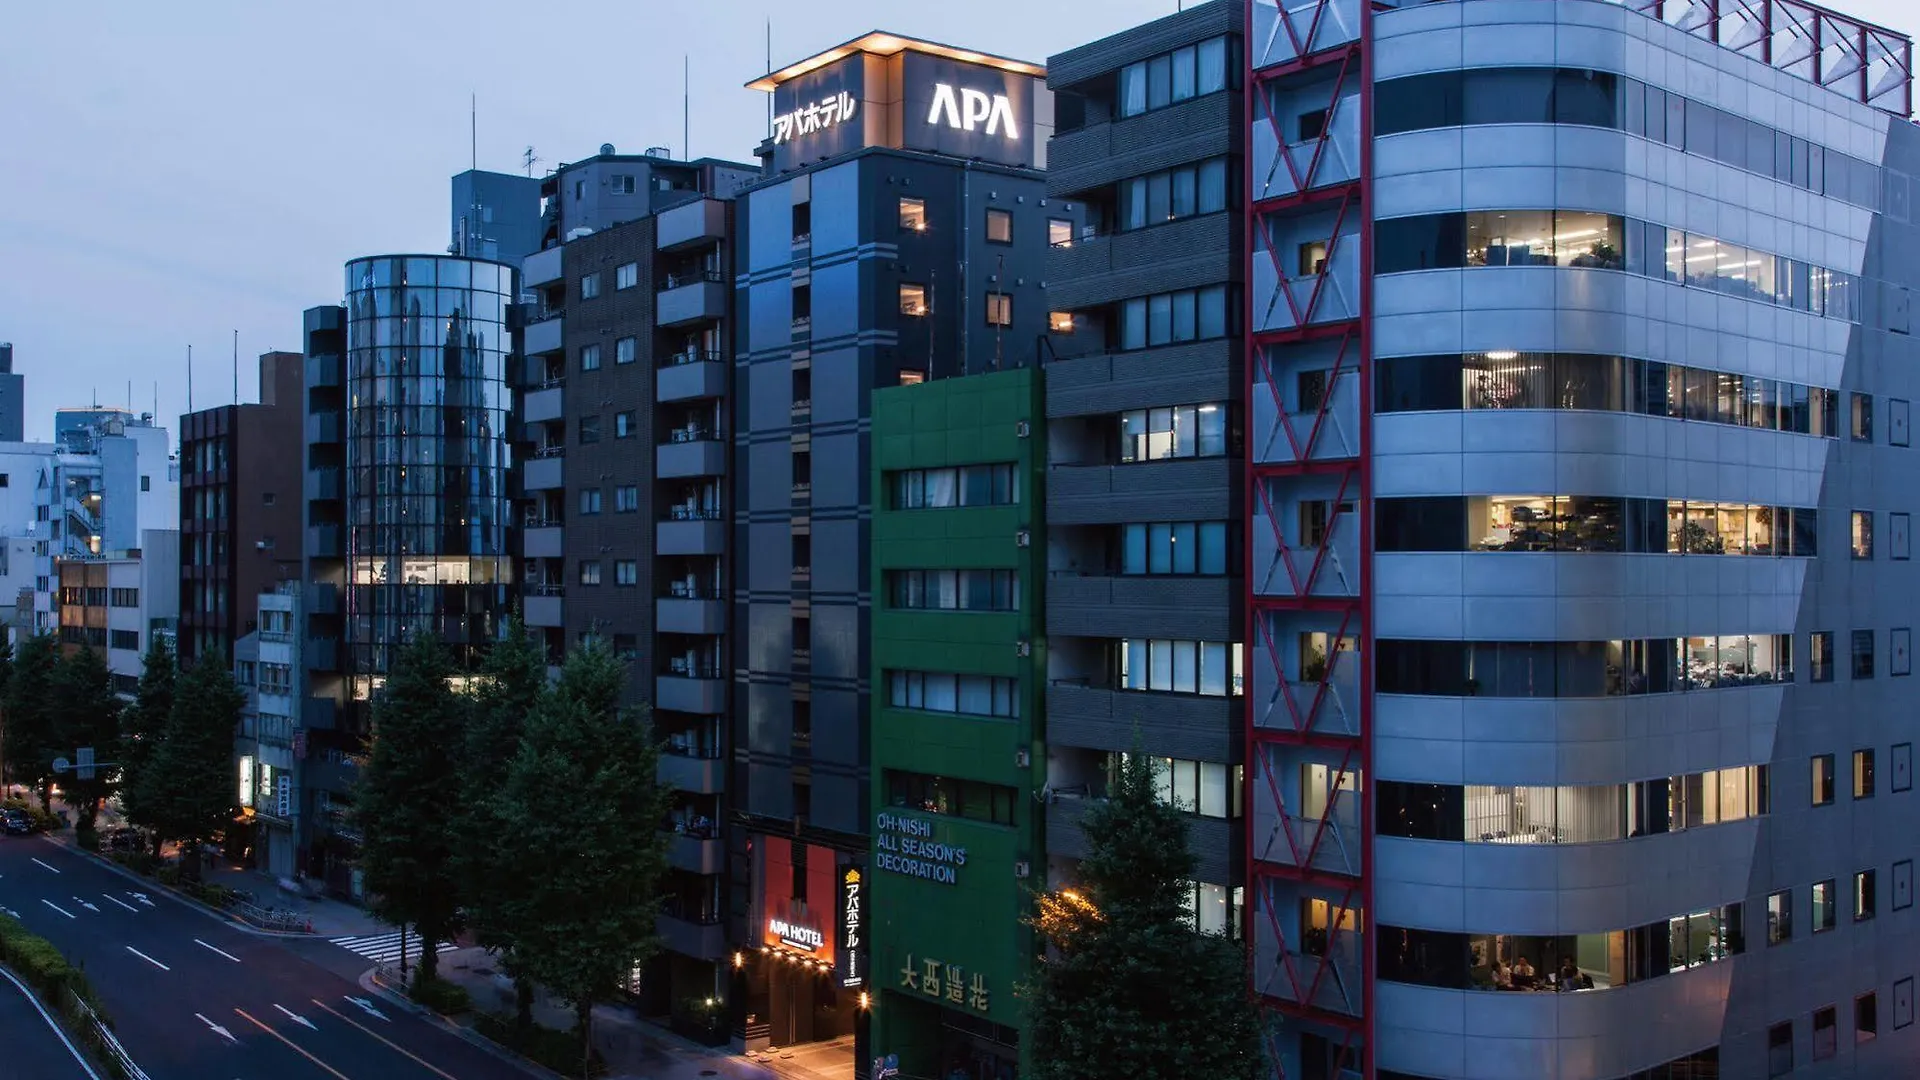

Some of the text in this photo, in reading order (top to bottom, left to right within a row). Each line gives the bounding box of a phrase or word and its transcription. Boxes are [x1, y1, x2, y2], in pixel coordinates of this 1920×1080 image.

[774, 91, 855, 144] アパホテル
[928, 83, 1019, 139] APA
[877, 833, 966, 865] ALL SEASON'S
[877, 853, 956, 884] DECORATION
[769, 919, 790, 937] APA
[790, 925, 823, 948] HOTEL
[846, 884, 859, 948] アパホテル
[900, 954, 989, 1010] 大西造花
